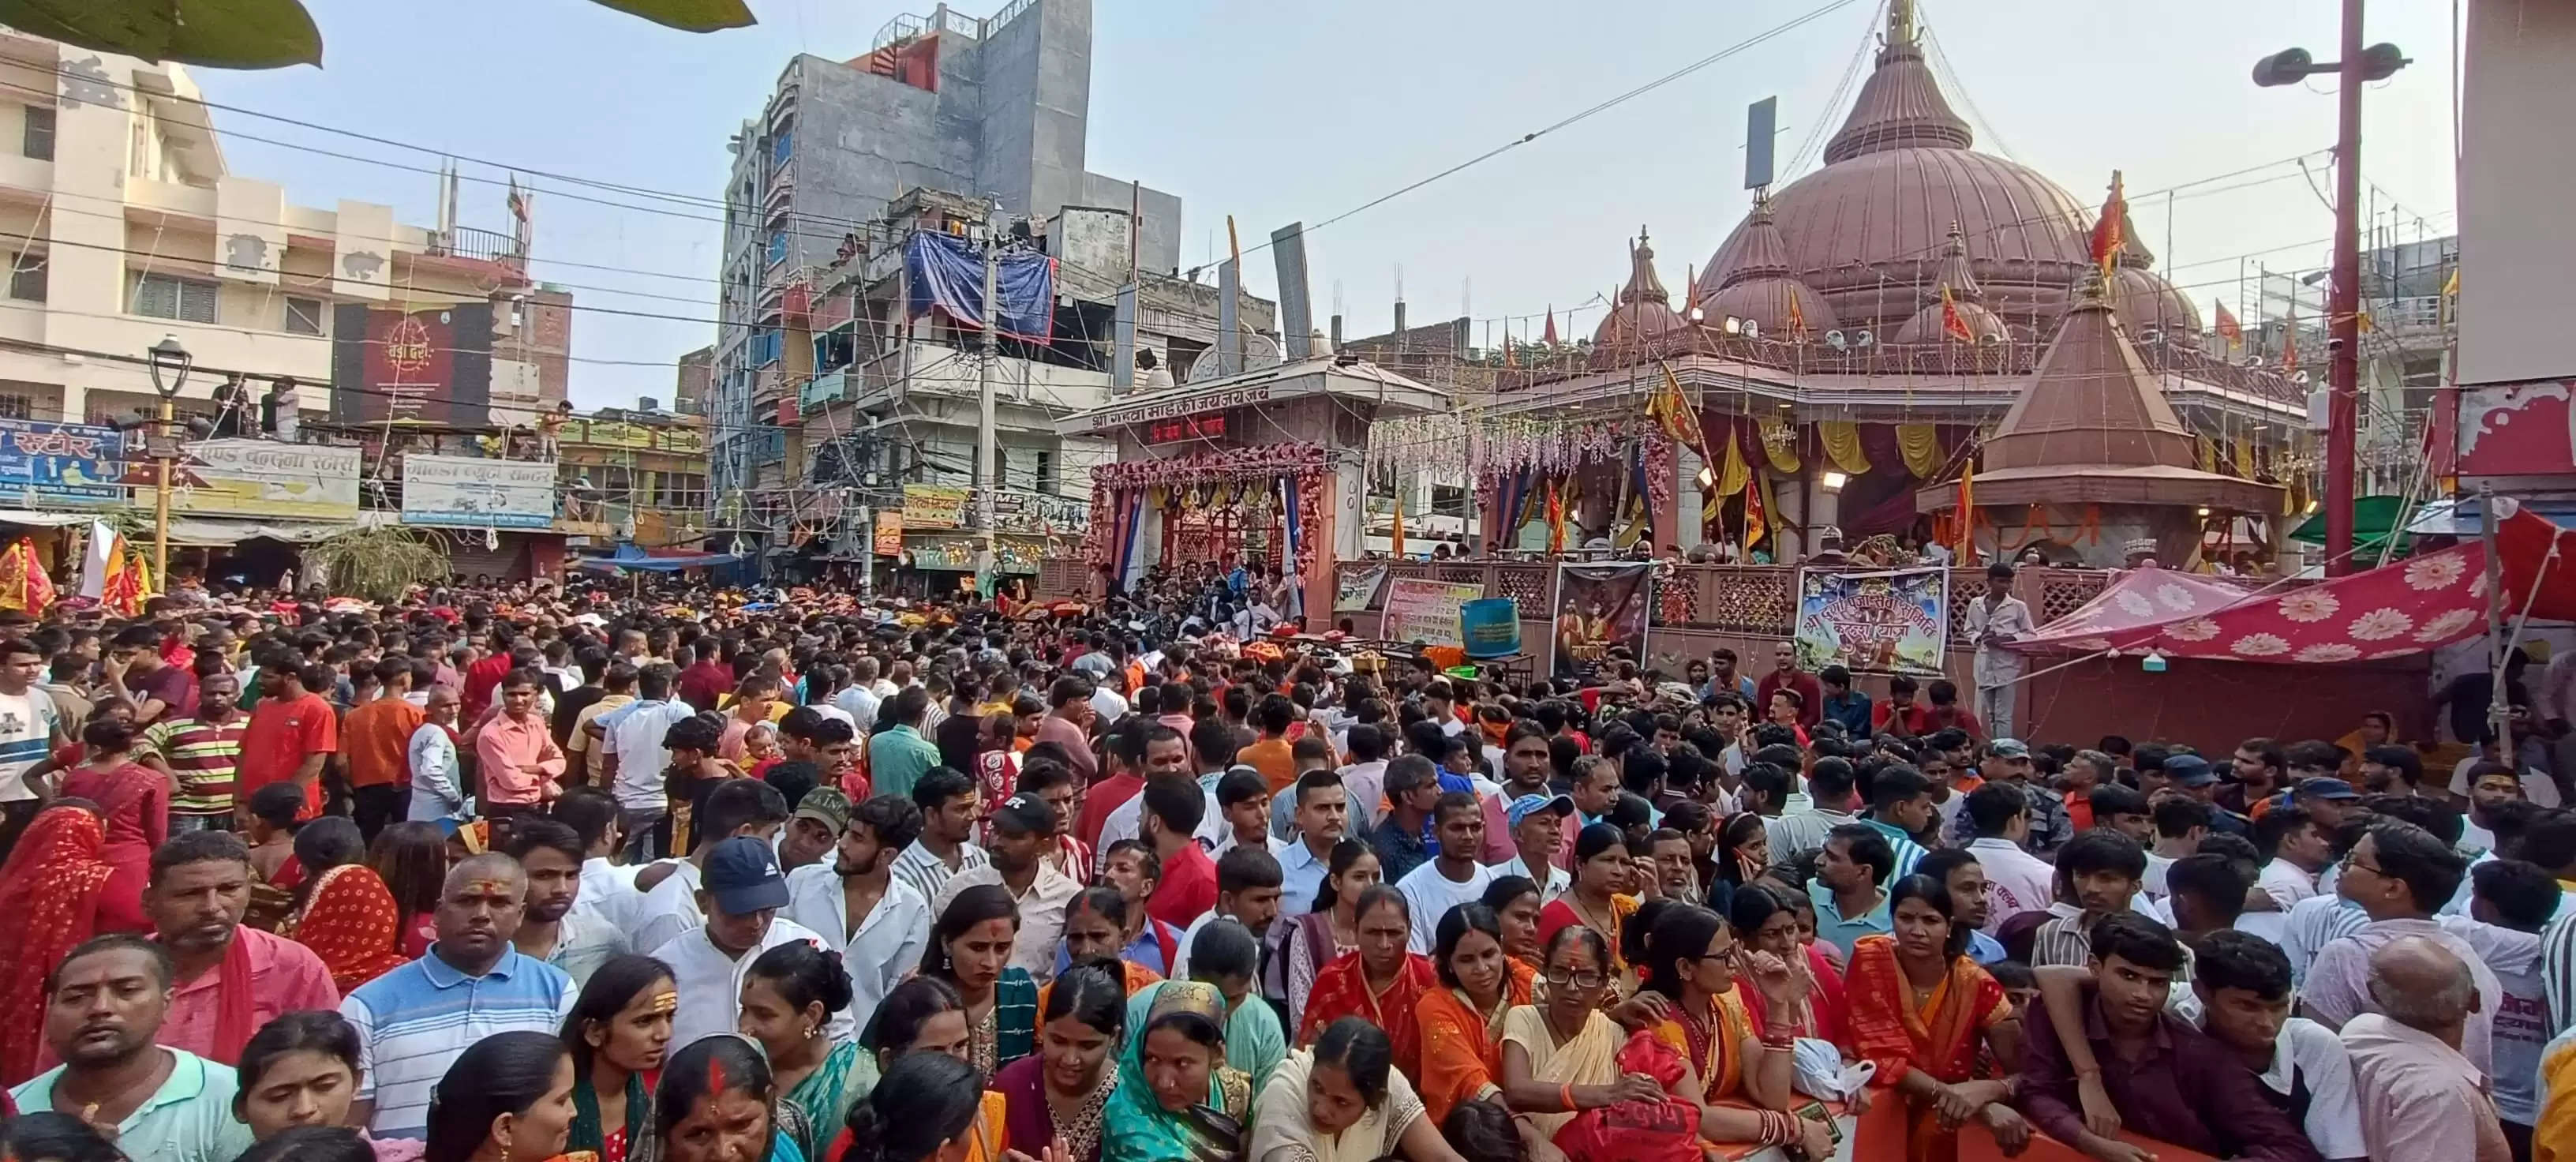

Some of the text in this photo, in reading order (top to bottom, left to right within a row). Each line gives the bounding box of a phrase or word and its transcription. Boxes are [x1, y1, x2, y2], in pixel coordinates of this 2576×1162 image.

[1092, 413, 1107, 429] श्री
[1803, 594, 1938, 638] श्री दुर्गा पूजा सेवा समिति
[1876, 622, 1911, 639] यात्रा
